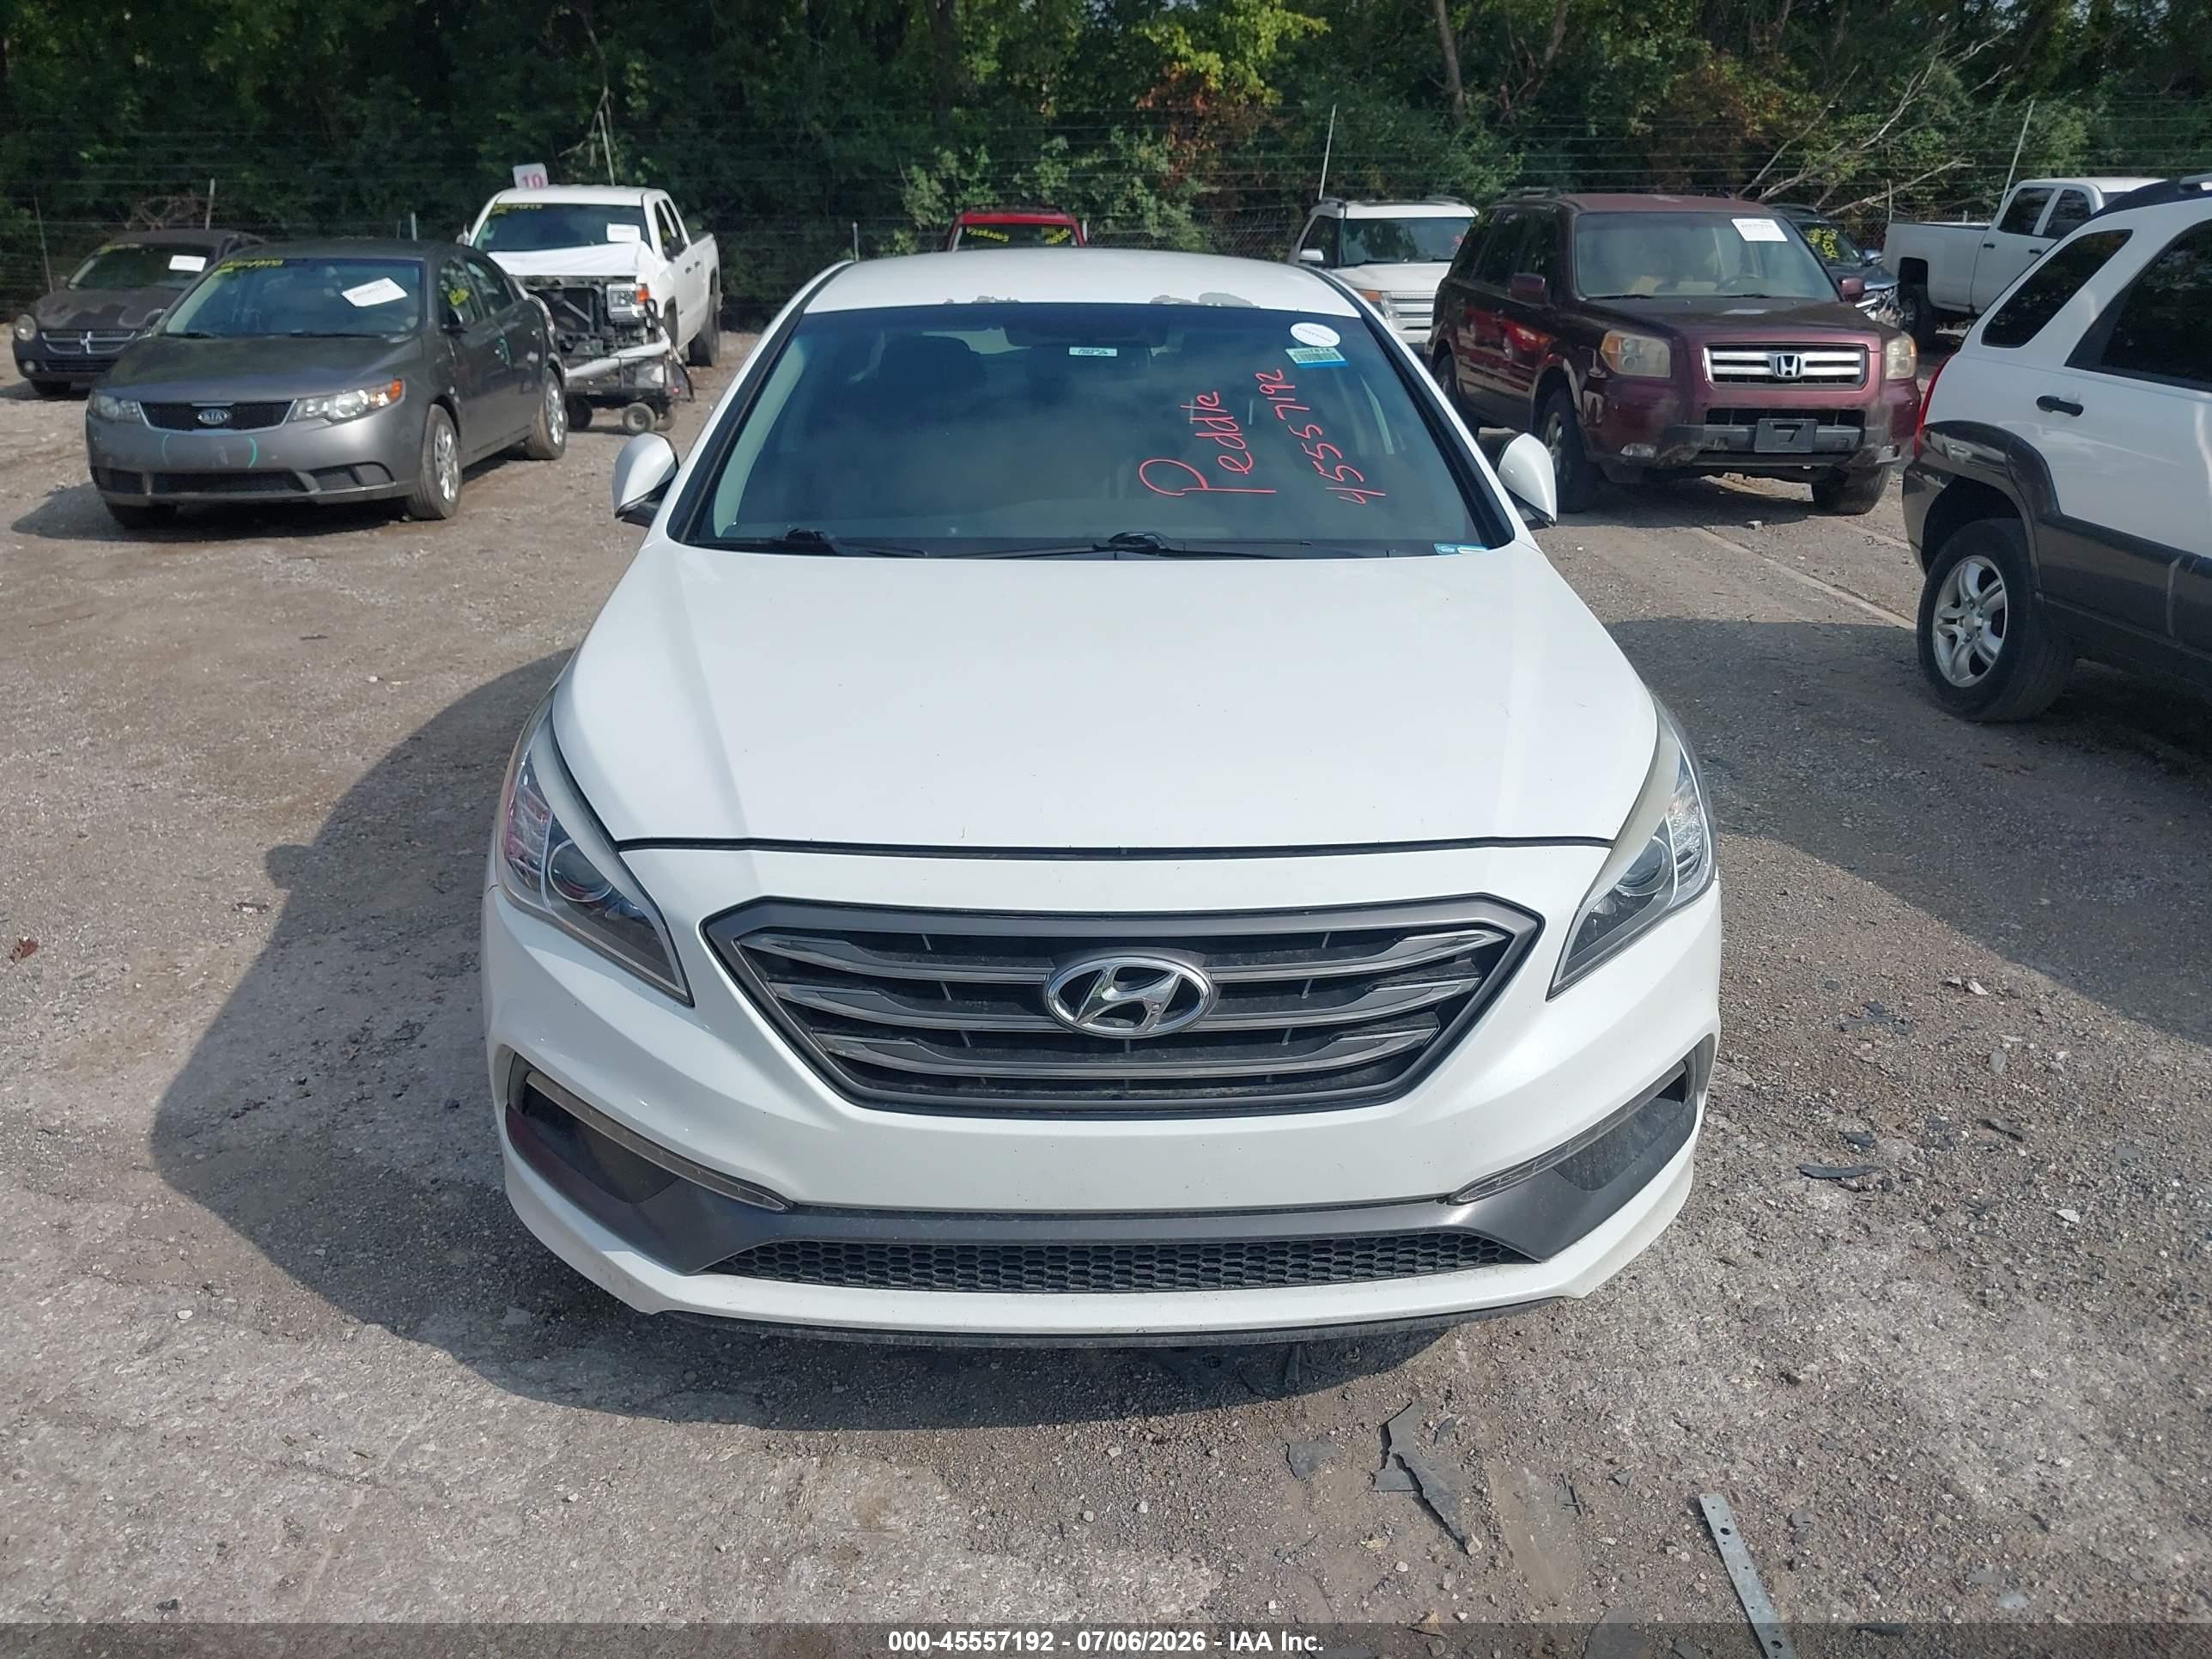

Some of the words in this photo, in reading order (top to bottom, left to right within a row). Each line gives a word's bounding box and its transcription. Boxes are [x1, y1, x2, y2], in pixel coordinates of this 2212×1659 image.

[521, 173, 544, 190] 10
[1139, 392, 1277, 496] Peddle
[1255, 368, 1387, 505] 45557192
